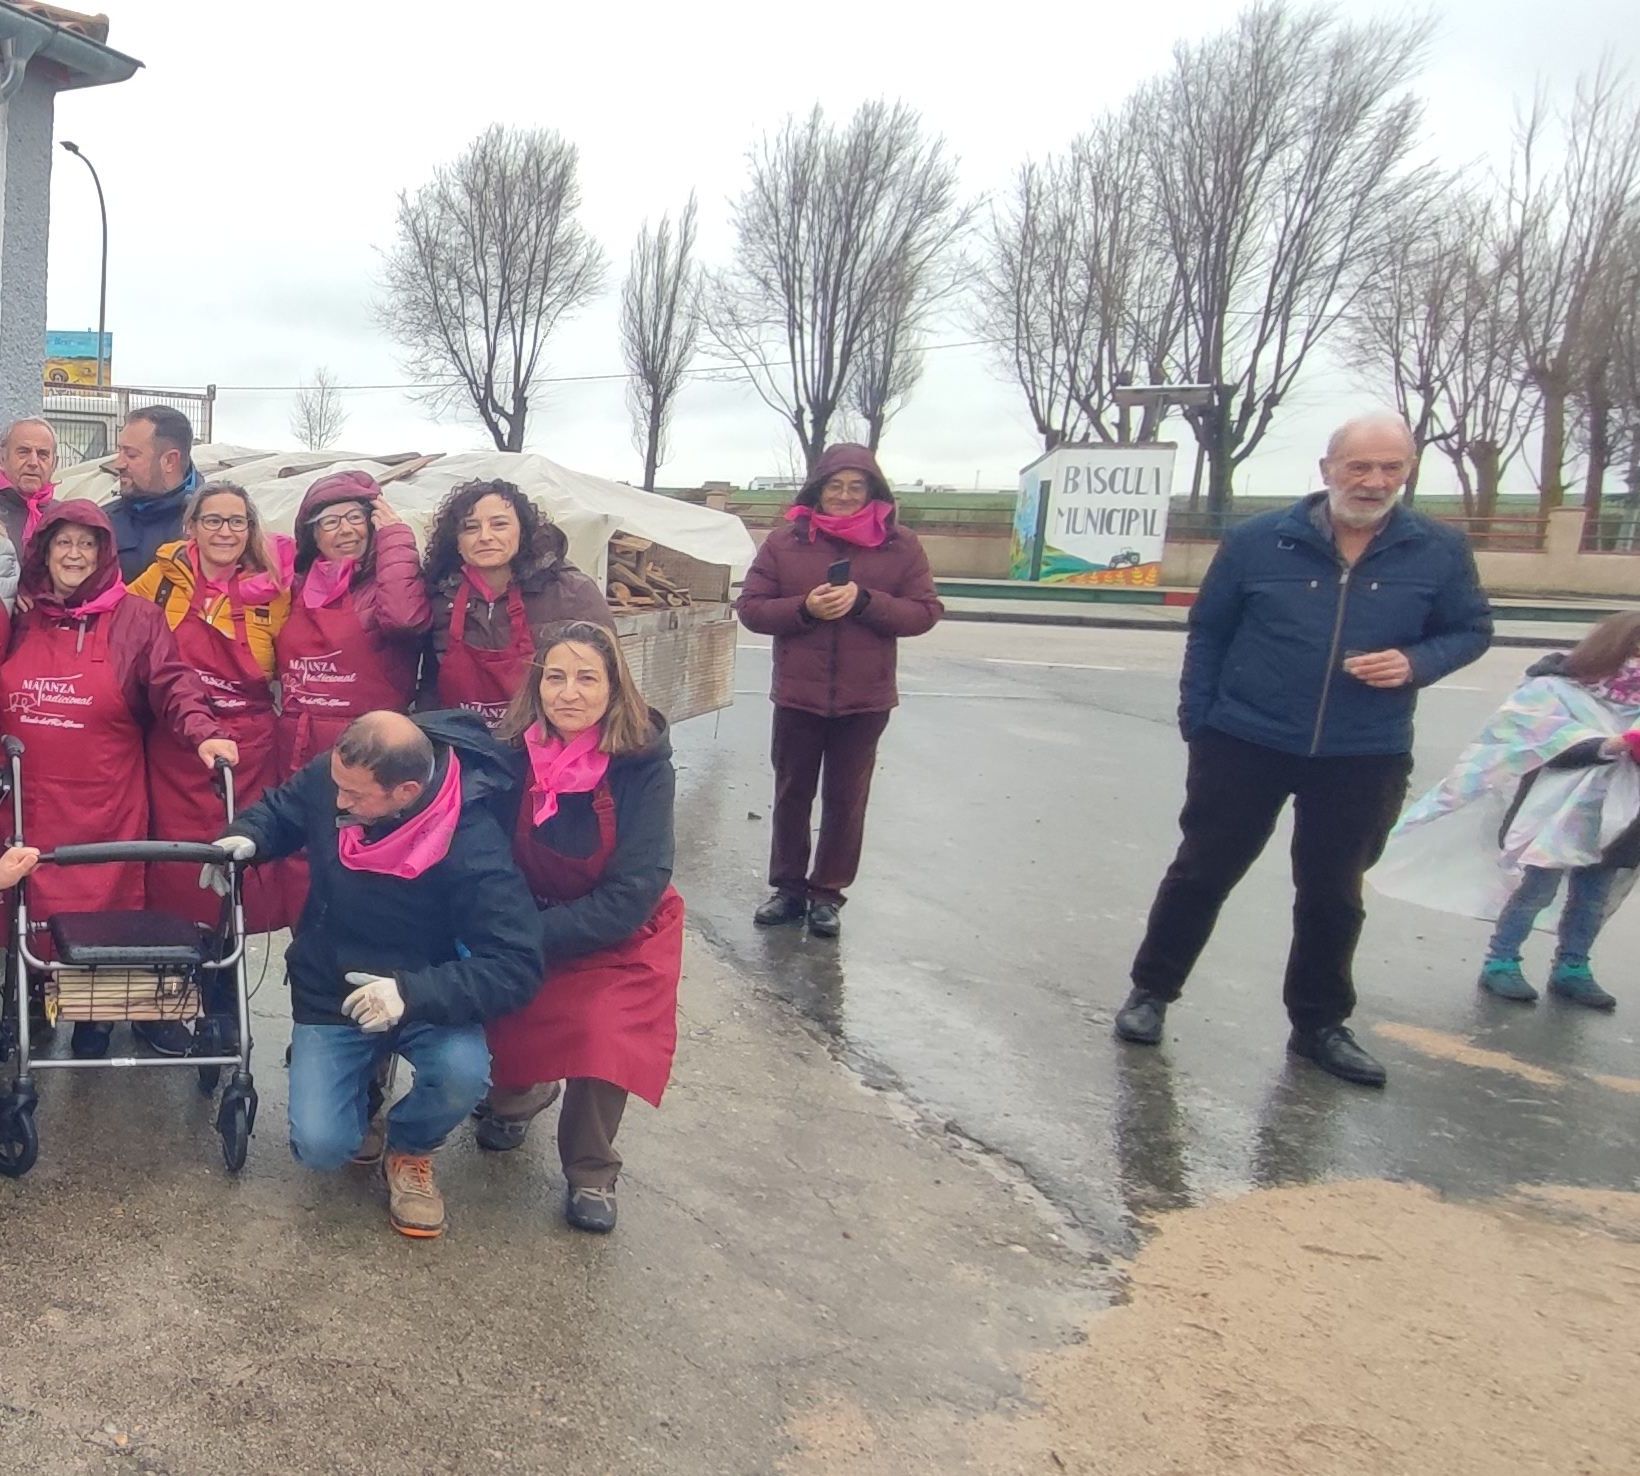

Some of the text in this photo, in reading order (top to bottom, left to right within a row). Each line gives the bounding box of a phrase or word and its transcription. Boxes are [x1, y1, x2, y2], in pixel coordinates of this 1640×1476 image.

[1055, 506, 1161, 537] MUNICIPAL
[288, 650, 343, 675] MATANZA
[21, 673, 83, 697] MATANZA
